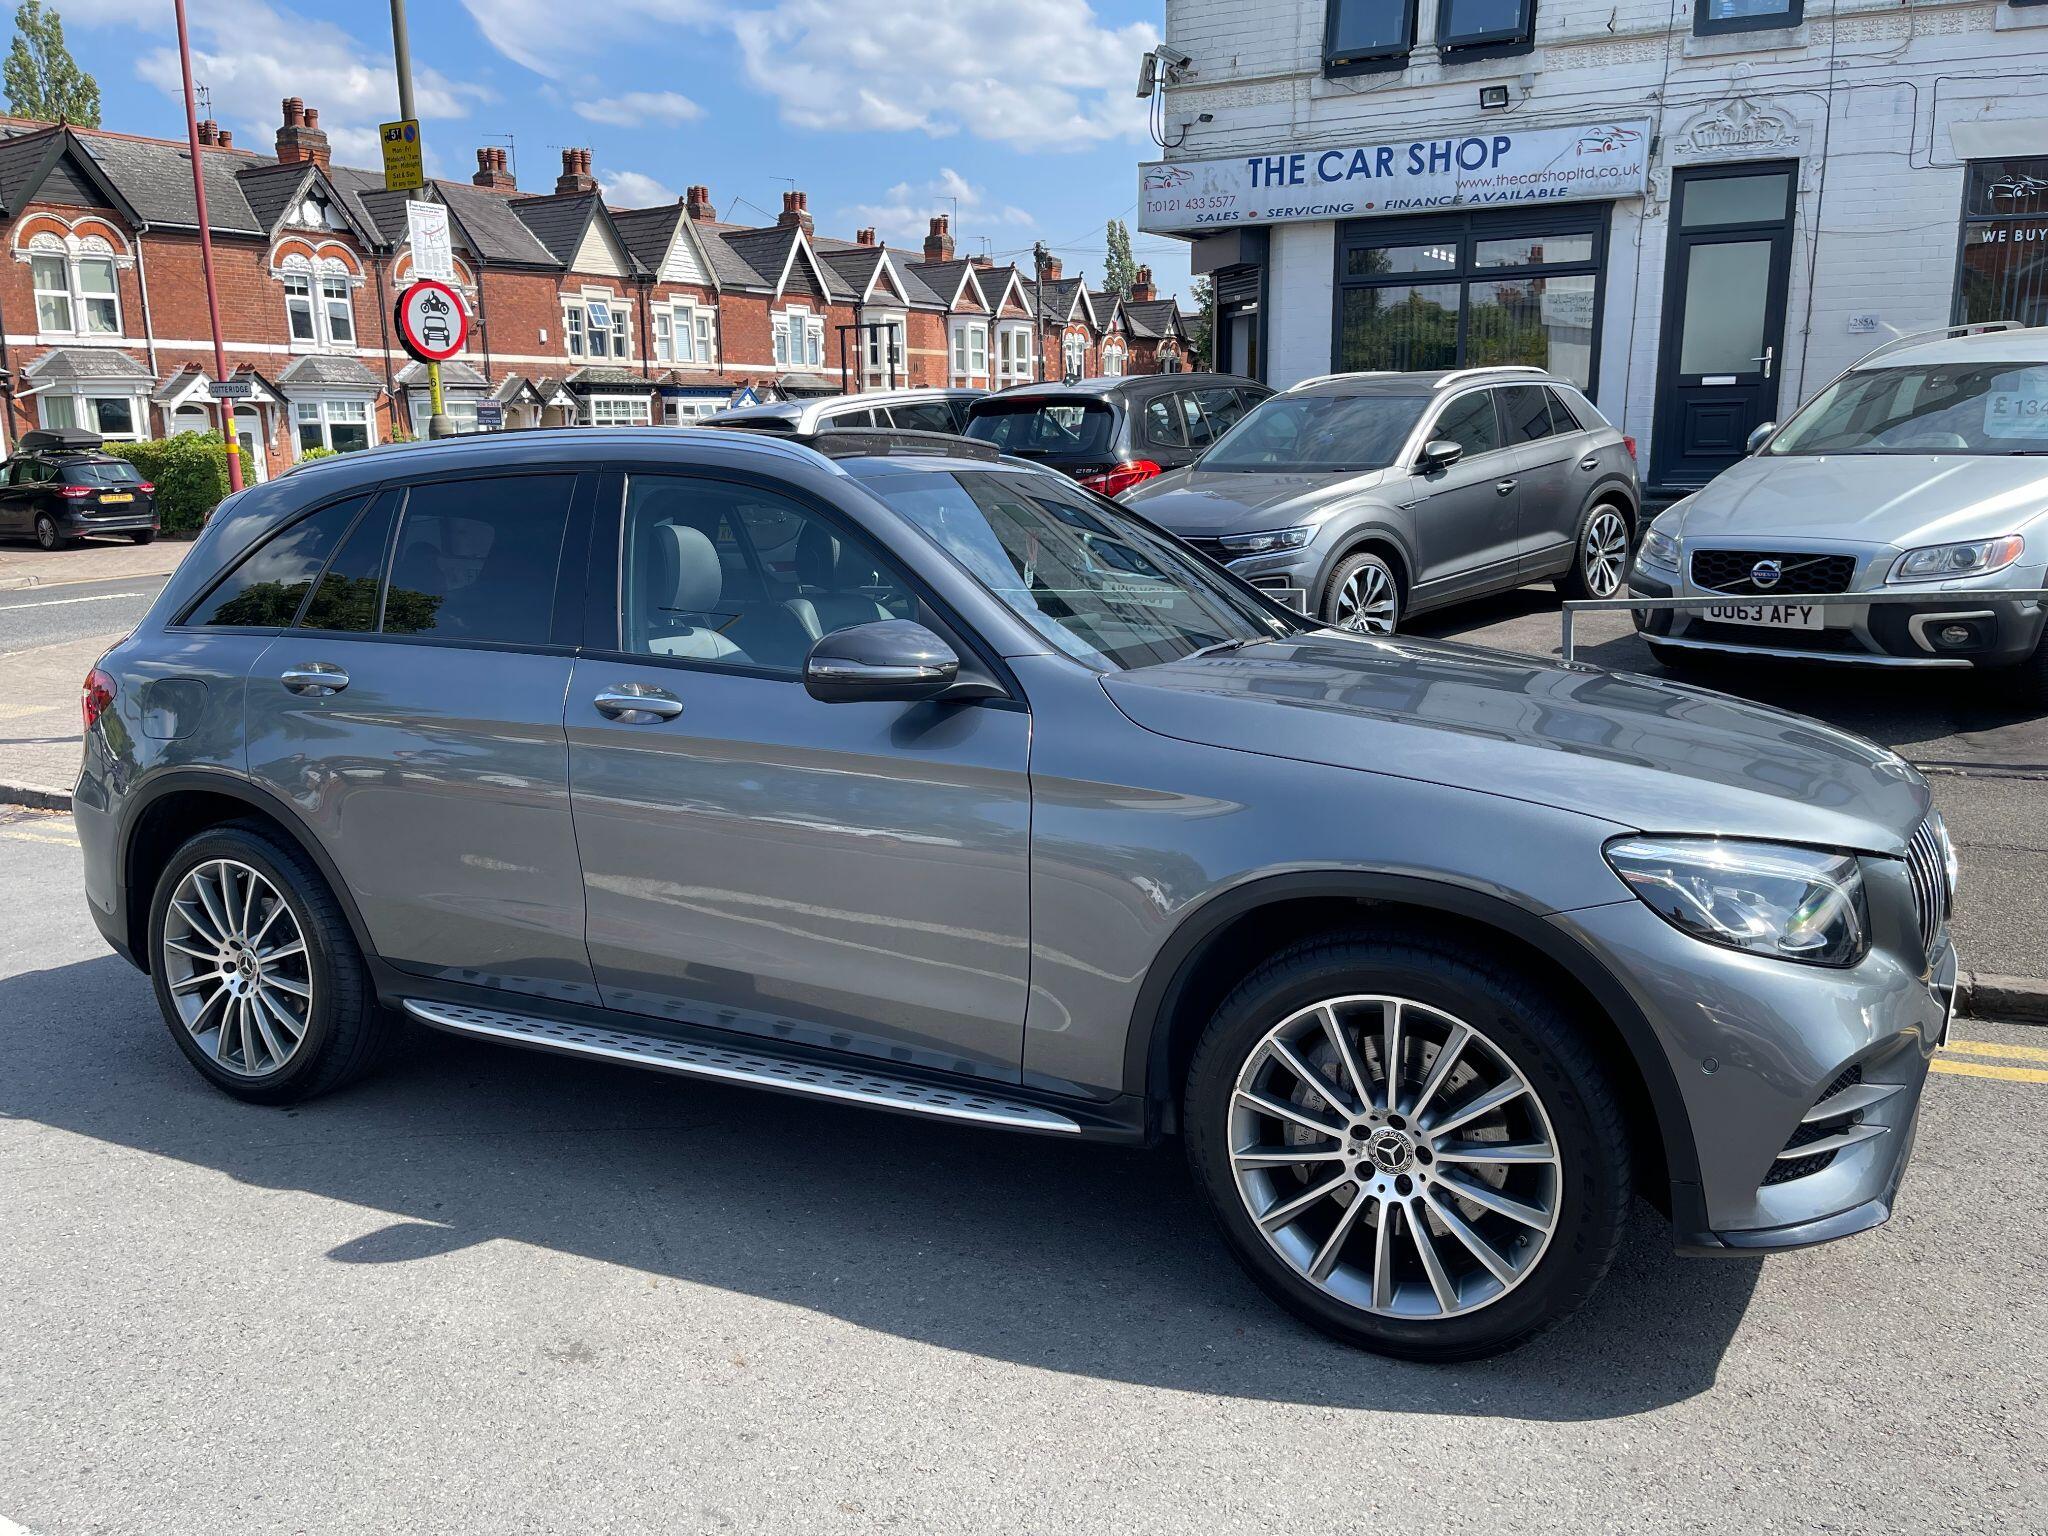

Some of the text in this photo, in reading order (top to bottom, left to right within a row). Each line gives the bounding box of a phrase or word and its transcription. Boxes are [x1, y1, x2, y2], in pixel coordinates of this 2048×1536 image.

[1248, 136, 1511, 188] THE CAR SHOP
[1455, 163, 1640, 189] www.thecarshopltd.co.uk
[1185, 197, 1206, 210] 433
[1208, 195, 1236, 208] 5577
[1196, 187, 1569, 222] SALES SERVICING FINANCE AVAILABLE
[1982, 228, 2048, 243] WE BUY
[210, 385, 249, 394] COTTERIDGE
[430, 377, 437, 388] 6
[1769, 604, 1812, 625] AFY
